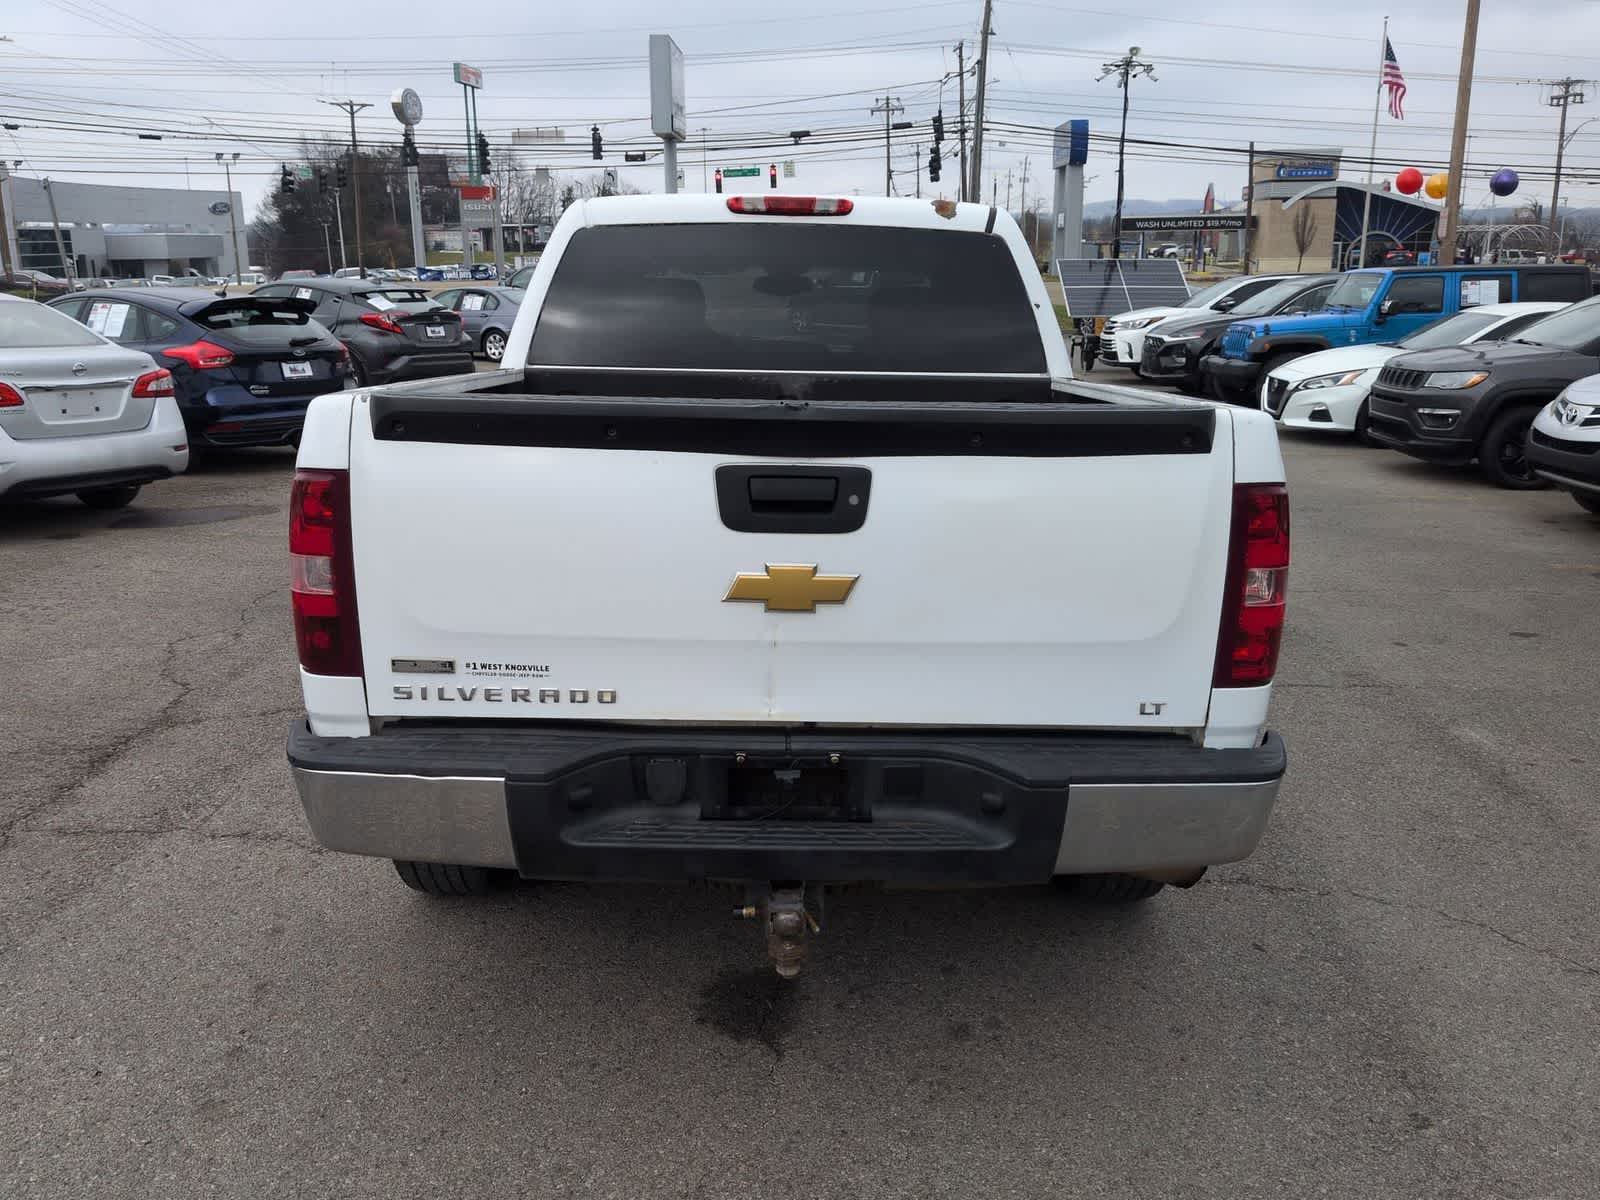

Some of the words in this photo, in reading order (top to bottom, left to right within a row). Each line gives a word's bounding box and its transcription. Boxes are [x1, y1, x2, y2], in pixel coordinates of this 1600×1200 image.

[1135, 220, 1160, 229] WASH
[1161, 219, 1205, 229] UNLIMITED
[480, 662, 503, 671] WEST
[504, 663, 550, 672] KNOXVILLE
[392, 684, 617, 704] SILVERADO
[1139, 702, 1167, 715] LT
